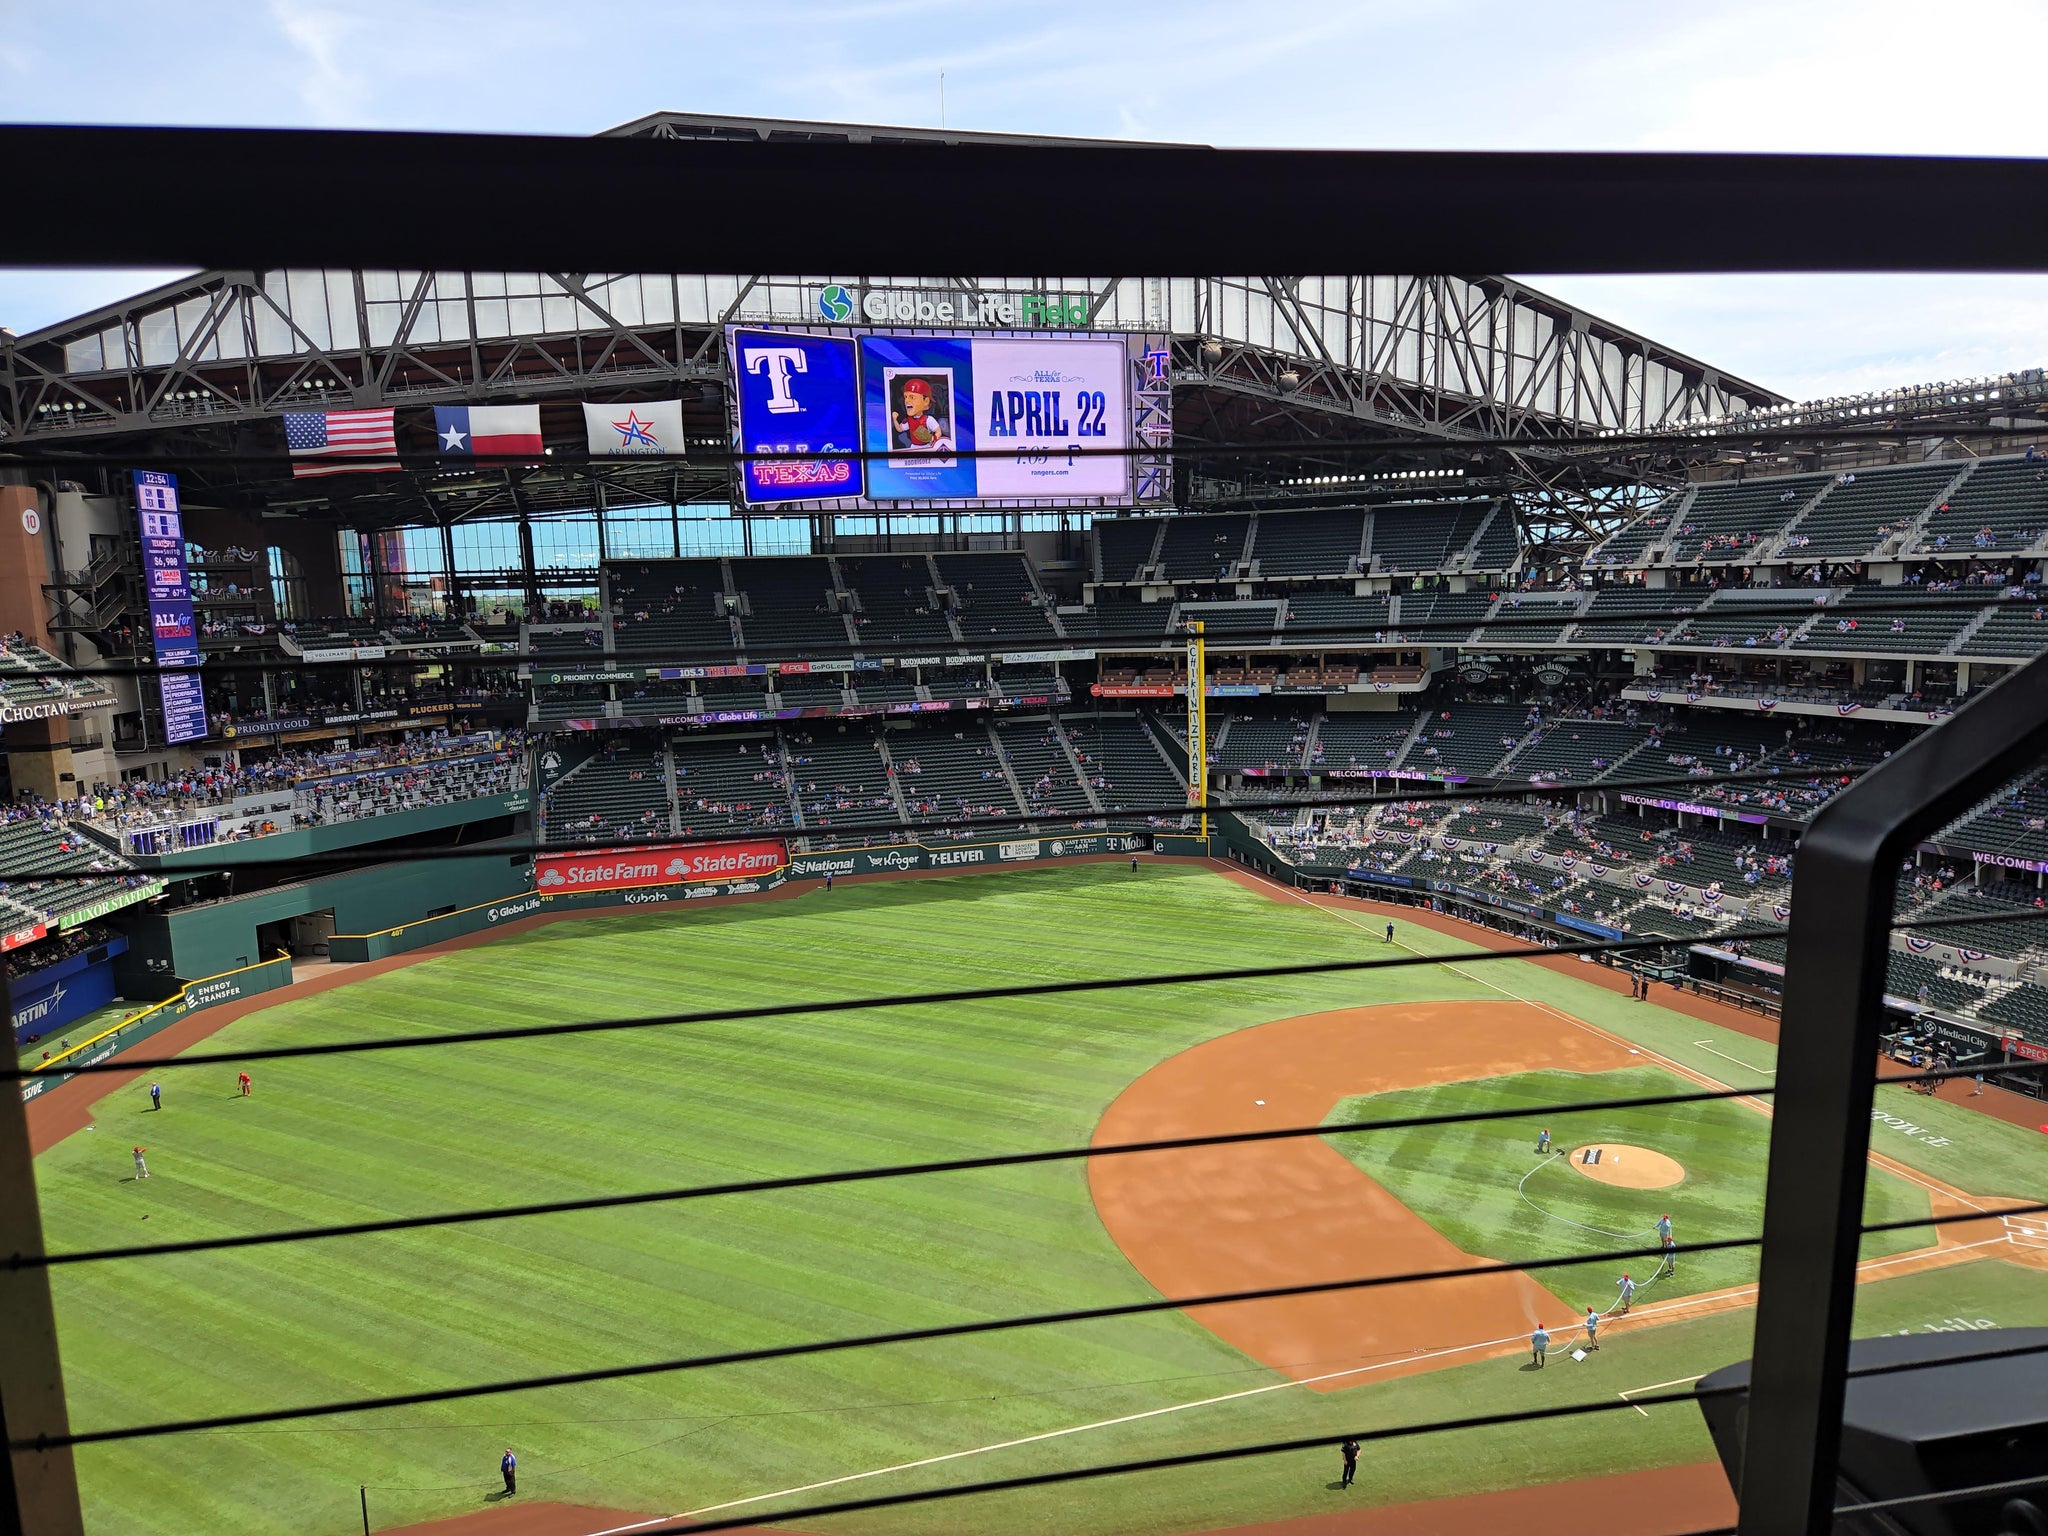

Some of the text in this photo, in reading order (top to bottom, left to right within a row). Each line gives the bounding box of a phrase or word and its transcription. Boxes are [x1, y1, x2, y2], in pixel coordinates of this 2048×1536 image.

[863, 293, 1087, 324] Globe Life Field
[744, 348, 808, 414] T
[989, 390, 1106, 436] APRIL 22
[754, 445, 818, 466] ALL
[145, 474, 166, 484] 12:54
[753, 463, 850, 485] TEXAS
[25, 515, 36, 529] 10
[155, 612, 192, 633] ALL for
[155, 625, 192, 638] TEXAS
[900, 657, 941, 666] BODYARMOR
[945, 654, 985, 664] BODYARMOR
[1026, 652, 1049, 660] Mint
[679, 666, 746, 677] 105.3 THE FAN
[787, 664, 807, 672] PGL
[811, 662, 852, 671] GoPGL.com
[1458, 661, 1494, 674] JACK DANIEL'S
[1532, 661, 1571, 676] JACK DANIEL'S
[563, 672, 634, 682] PRIORITY COMMERCE
[1189, 647, 1197, 708] CHIKIN
[2, 702, 69, 722] CHOCTAW
[410, 703, 455, 714] PLUCKERS
[325, 709, 398, 724] HARGROVE ROOFING
[658, 716, 698, 725] WELCOME
[718, 712, 741, 721] Globe
[742, 711, 758, 720] Life
[758, 710, 777, 719] Field
[237, 719, 310, 734] PRIORITY GOLD
[1328, 770, 1444, 782] WELCOME TO Globe Life Field
[1620, 793, 1658, 807] WELCOME
[1660, 799, 1671, 809] TO
[1677, 802, 1702, 814] Globe
[1702, 806, 1718, 817] Life
[1107, 837, 1117, 851] T
[806, 857, 855, 873] National
[884, 851, 920, 871] Kroger
[929, 849, 985, 866] 7-ELEVEN
[1972, 851, 2048, 874] WELCOME T
[823, 868, 853, 877] Car Rental
[624, 891, 670, 904] Kubota
[1455, 887, 1476, 898] American
[71, 883, 162, 926] LUXOR STAFFING
[500, 898, 541, 917] Globe Life
[1507, 902, 1529, 913] American
[15, 928, 34, 942] DEX
[198, 980, 231, 996] ENERGY
[200, 987, 240, 1005] TRANSFER
[1938, 1026, 1988, 1049] Medical City
[91, 1050, 110, 1066] MARTIN
[2020, 1045, 2048, 1061] SPEC'S
